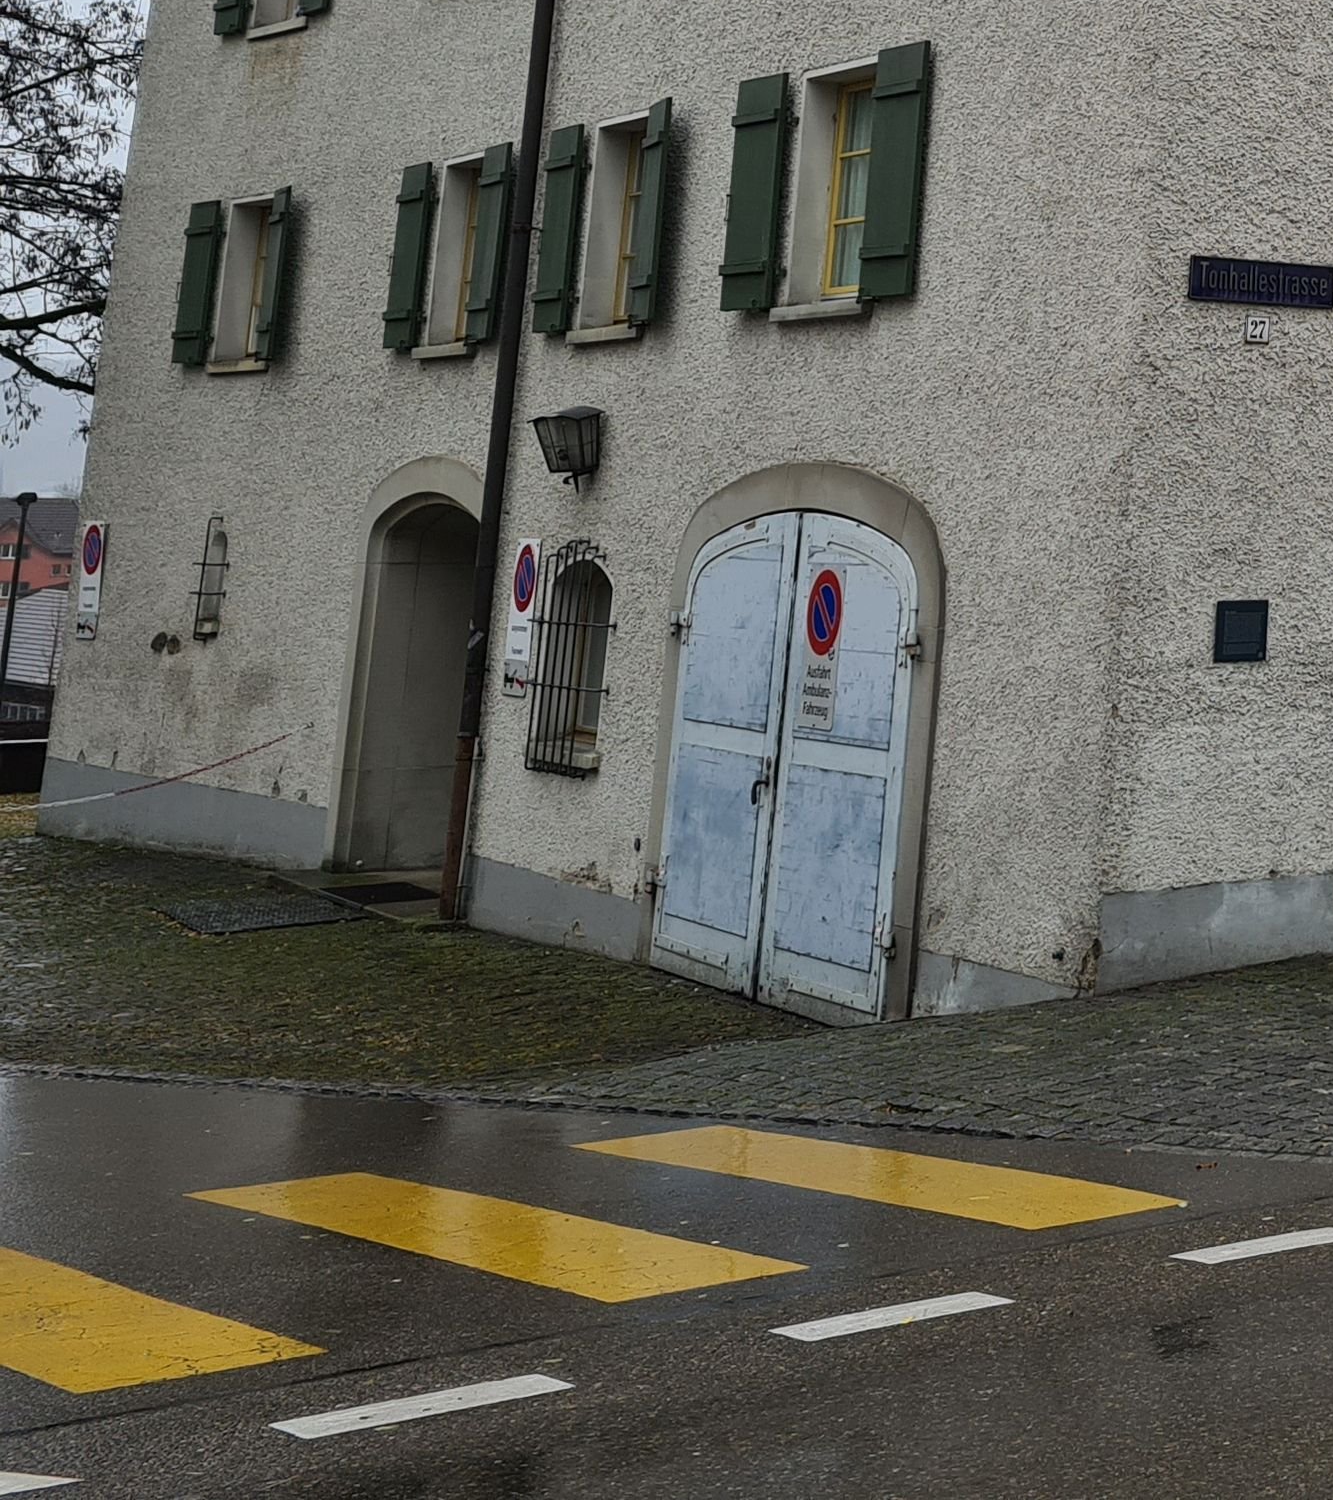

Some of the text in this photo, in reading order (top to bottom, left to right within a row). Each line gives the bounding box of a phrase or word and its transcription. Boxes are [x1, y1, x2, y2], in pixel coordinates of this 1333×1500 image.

[1200, 261, 1328, 297] Tonhallestrasse
[1249, 320, 1267, 339] 27
[806, 664, 831, 680] Ausfahrt
[802, 701, 828, 721] Fahrzeug
